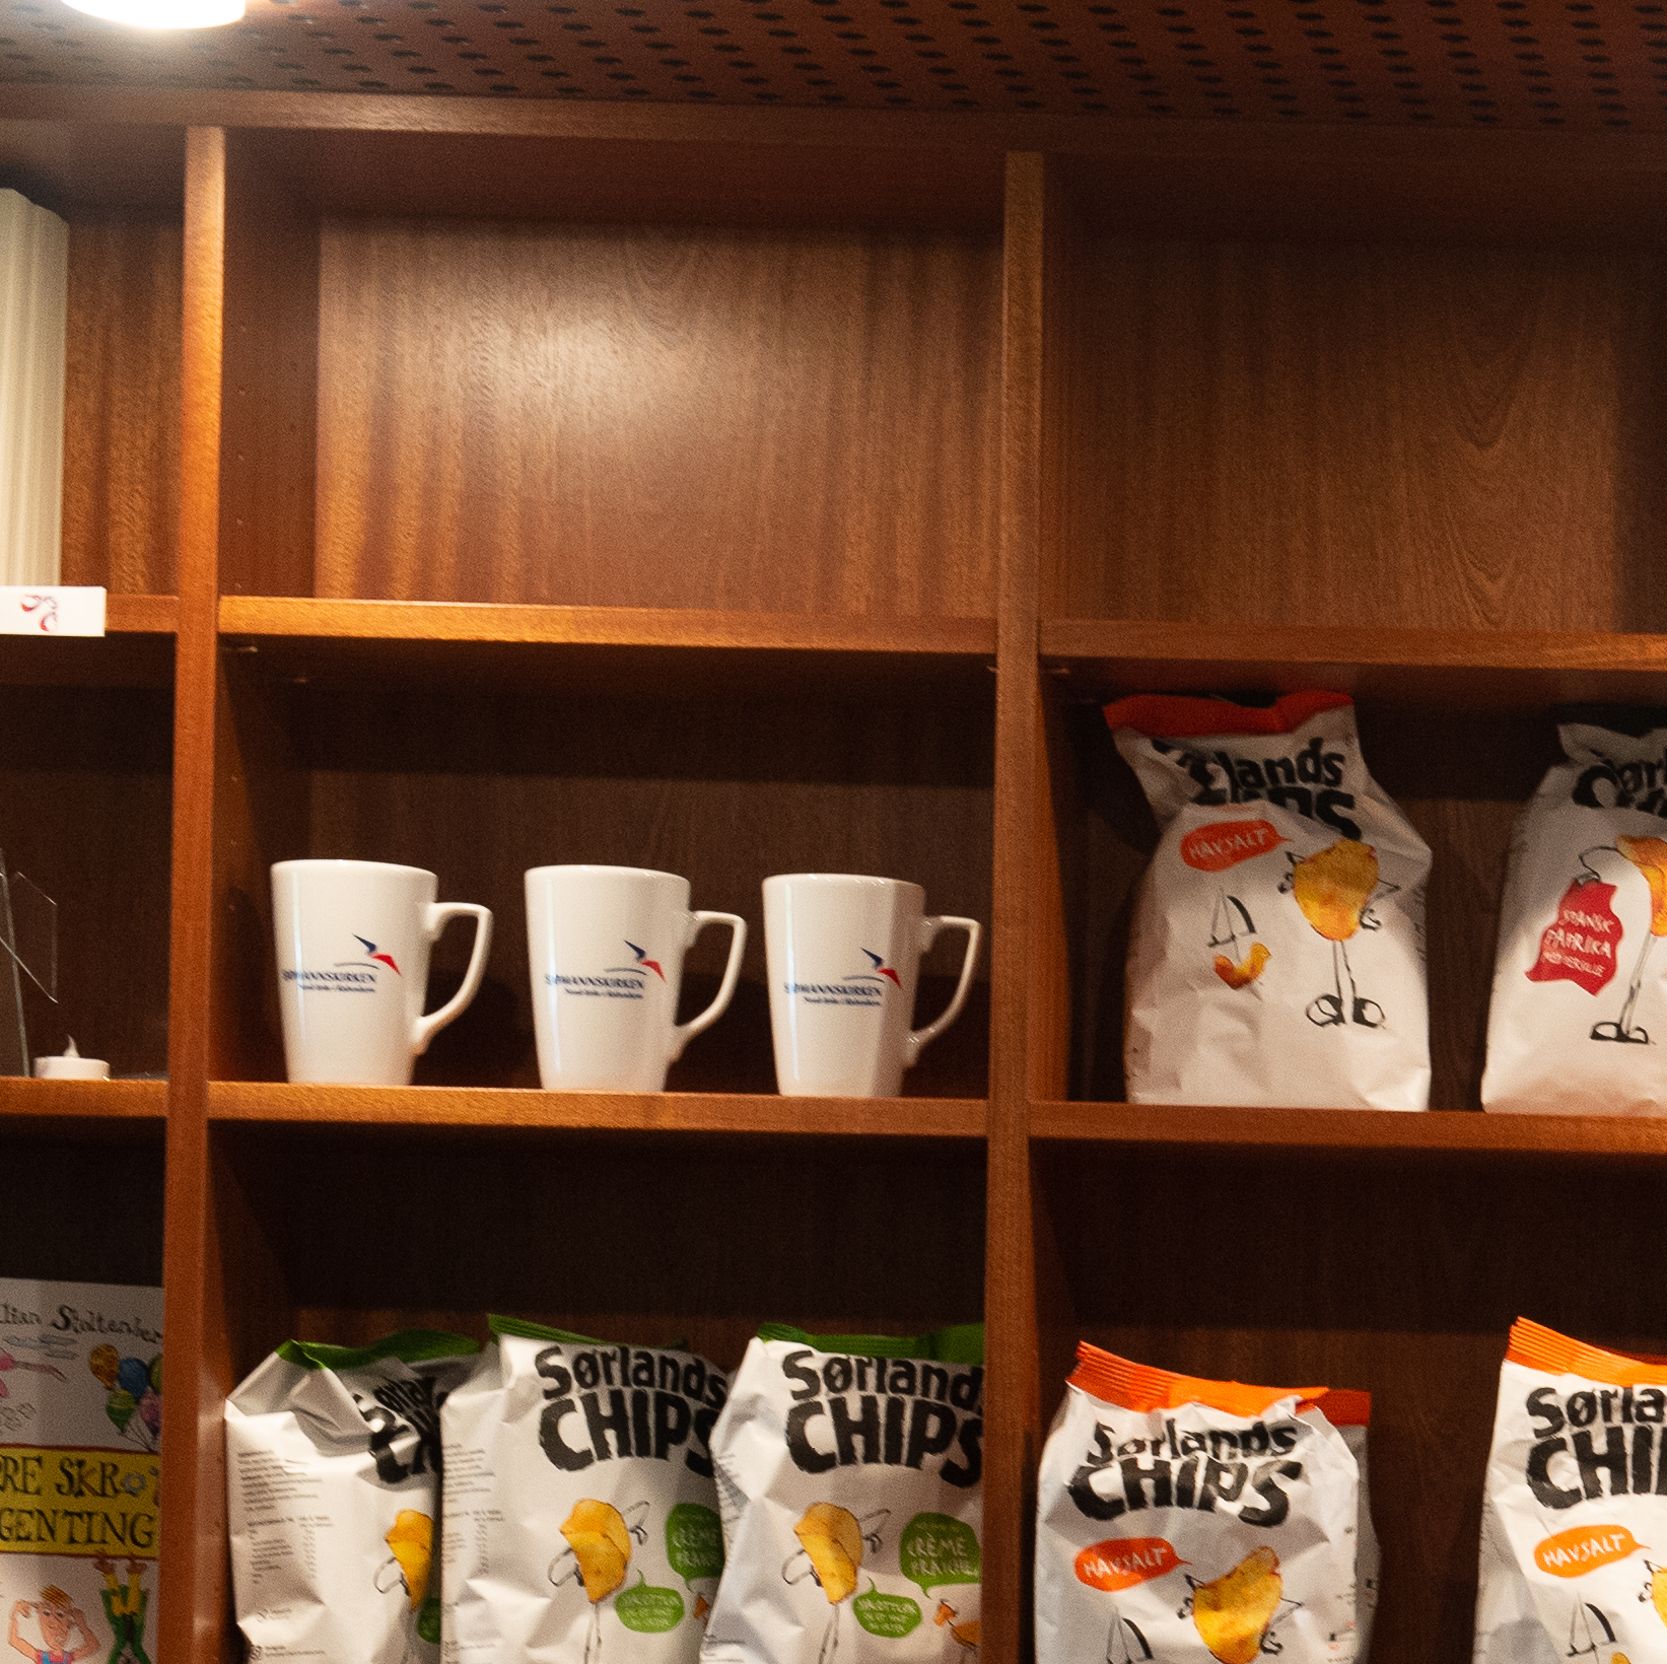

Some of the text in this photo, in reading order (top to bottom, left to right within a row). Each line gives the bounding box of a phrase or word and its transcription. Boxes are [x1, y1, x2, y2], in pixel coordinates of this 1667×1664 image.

[1188, 826, 1273, 864] HAVSALT
[1546, 928, 1612, 959] PAPRIKA
[534, 1345, 729, 1409] Sørlands
[782, 1350, 983, 1415] Sørland
[786, 1394, 983, 1488] CHIPS
[1086, 1419, 1299, 1465] Sørlands
[1069, 1453, 1303, 1528] CHIPS
[1082, 1546, 1169, 1579] HAVSALT
[1542, 1532, 1627, 1564] HAVSALT
